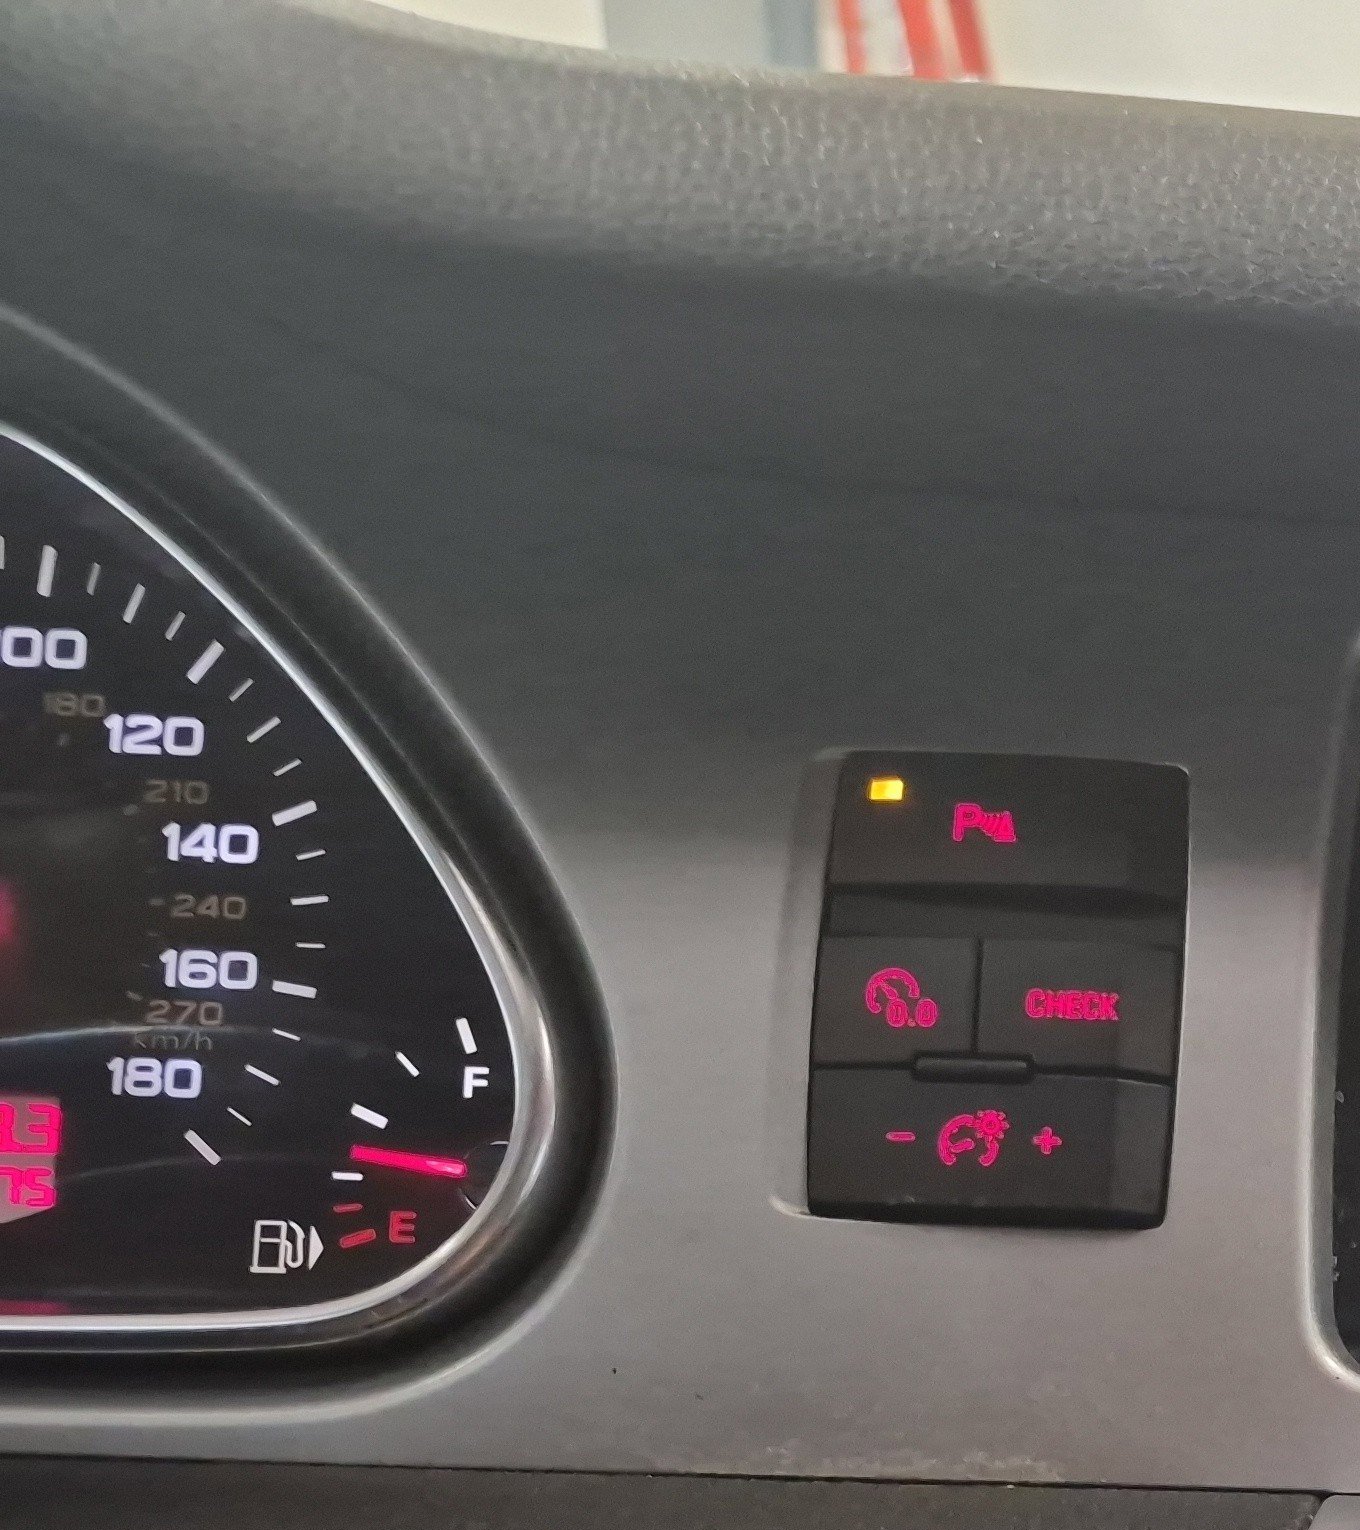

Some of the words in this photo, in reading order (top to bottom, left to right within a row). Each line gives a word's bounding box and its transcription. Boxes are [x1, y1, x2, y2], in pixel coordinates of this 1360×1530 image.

[0, 625, 88, 670] 00
[103, 713, 205, 757] 120
[143, 779, 211, 805] 210
[161, 822, 260, 865] 140
[170, 894, 249, 921] 240
[158, 948, 258, 990] 160
[144, 998, 225, 1028] 270
[1024, 987, 1120, 1021] CHECK
[106, 1056, 203, 1099] 180
[462, 1065, 490, 1099] F
[388, 1210, 418, 1244] E
